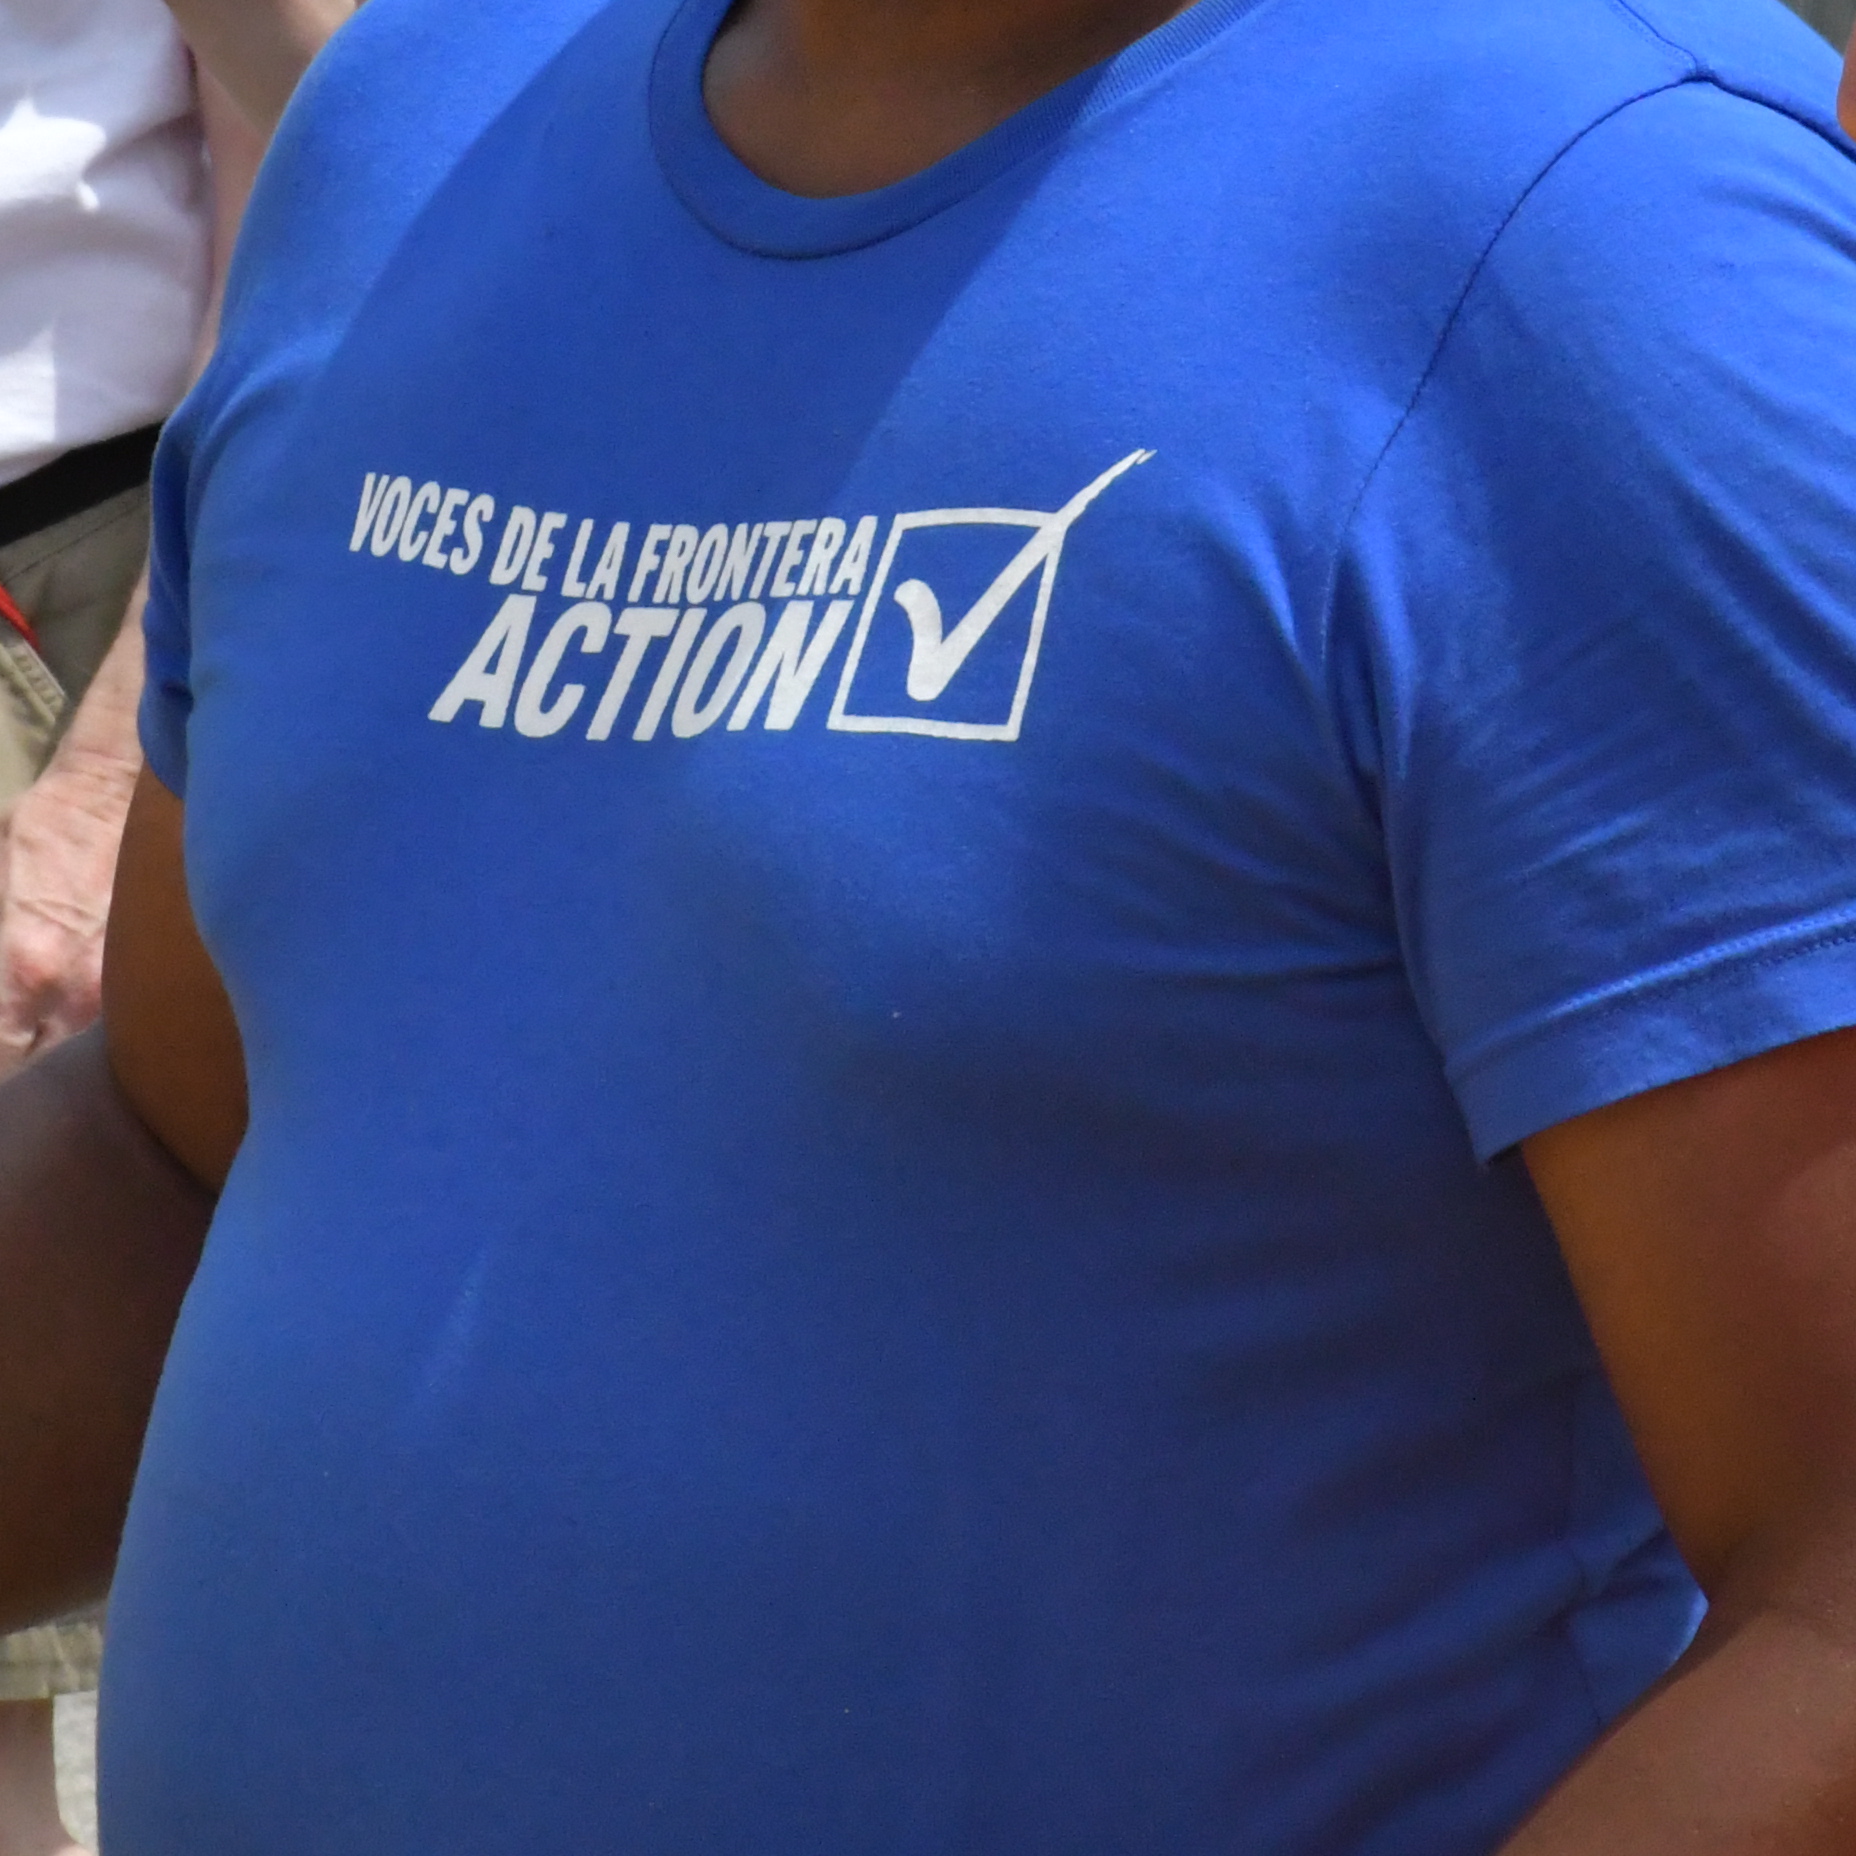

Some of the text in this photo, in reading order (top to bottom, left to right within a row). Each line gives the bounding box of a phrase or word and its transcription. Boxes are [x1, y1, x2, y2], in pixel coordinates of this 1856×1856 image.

[349, 472, 879, 605] VOCES DE LA FRONTERA
[428, 593, 855, 742] ACTION
